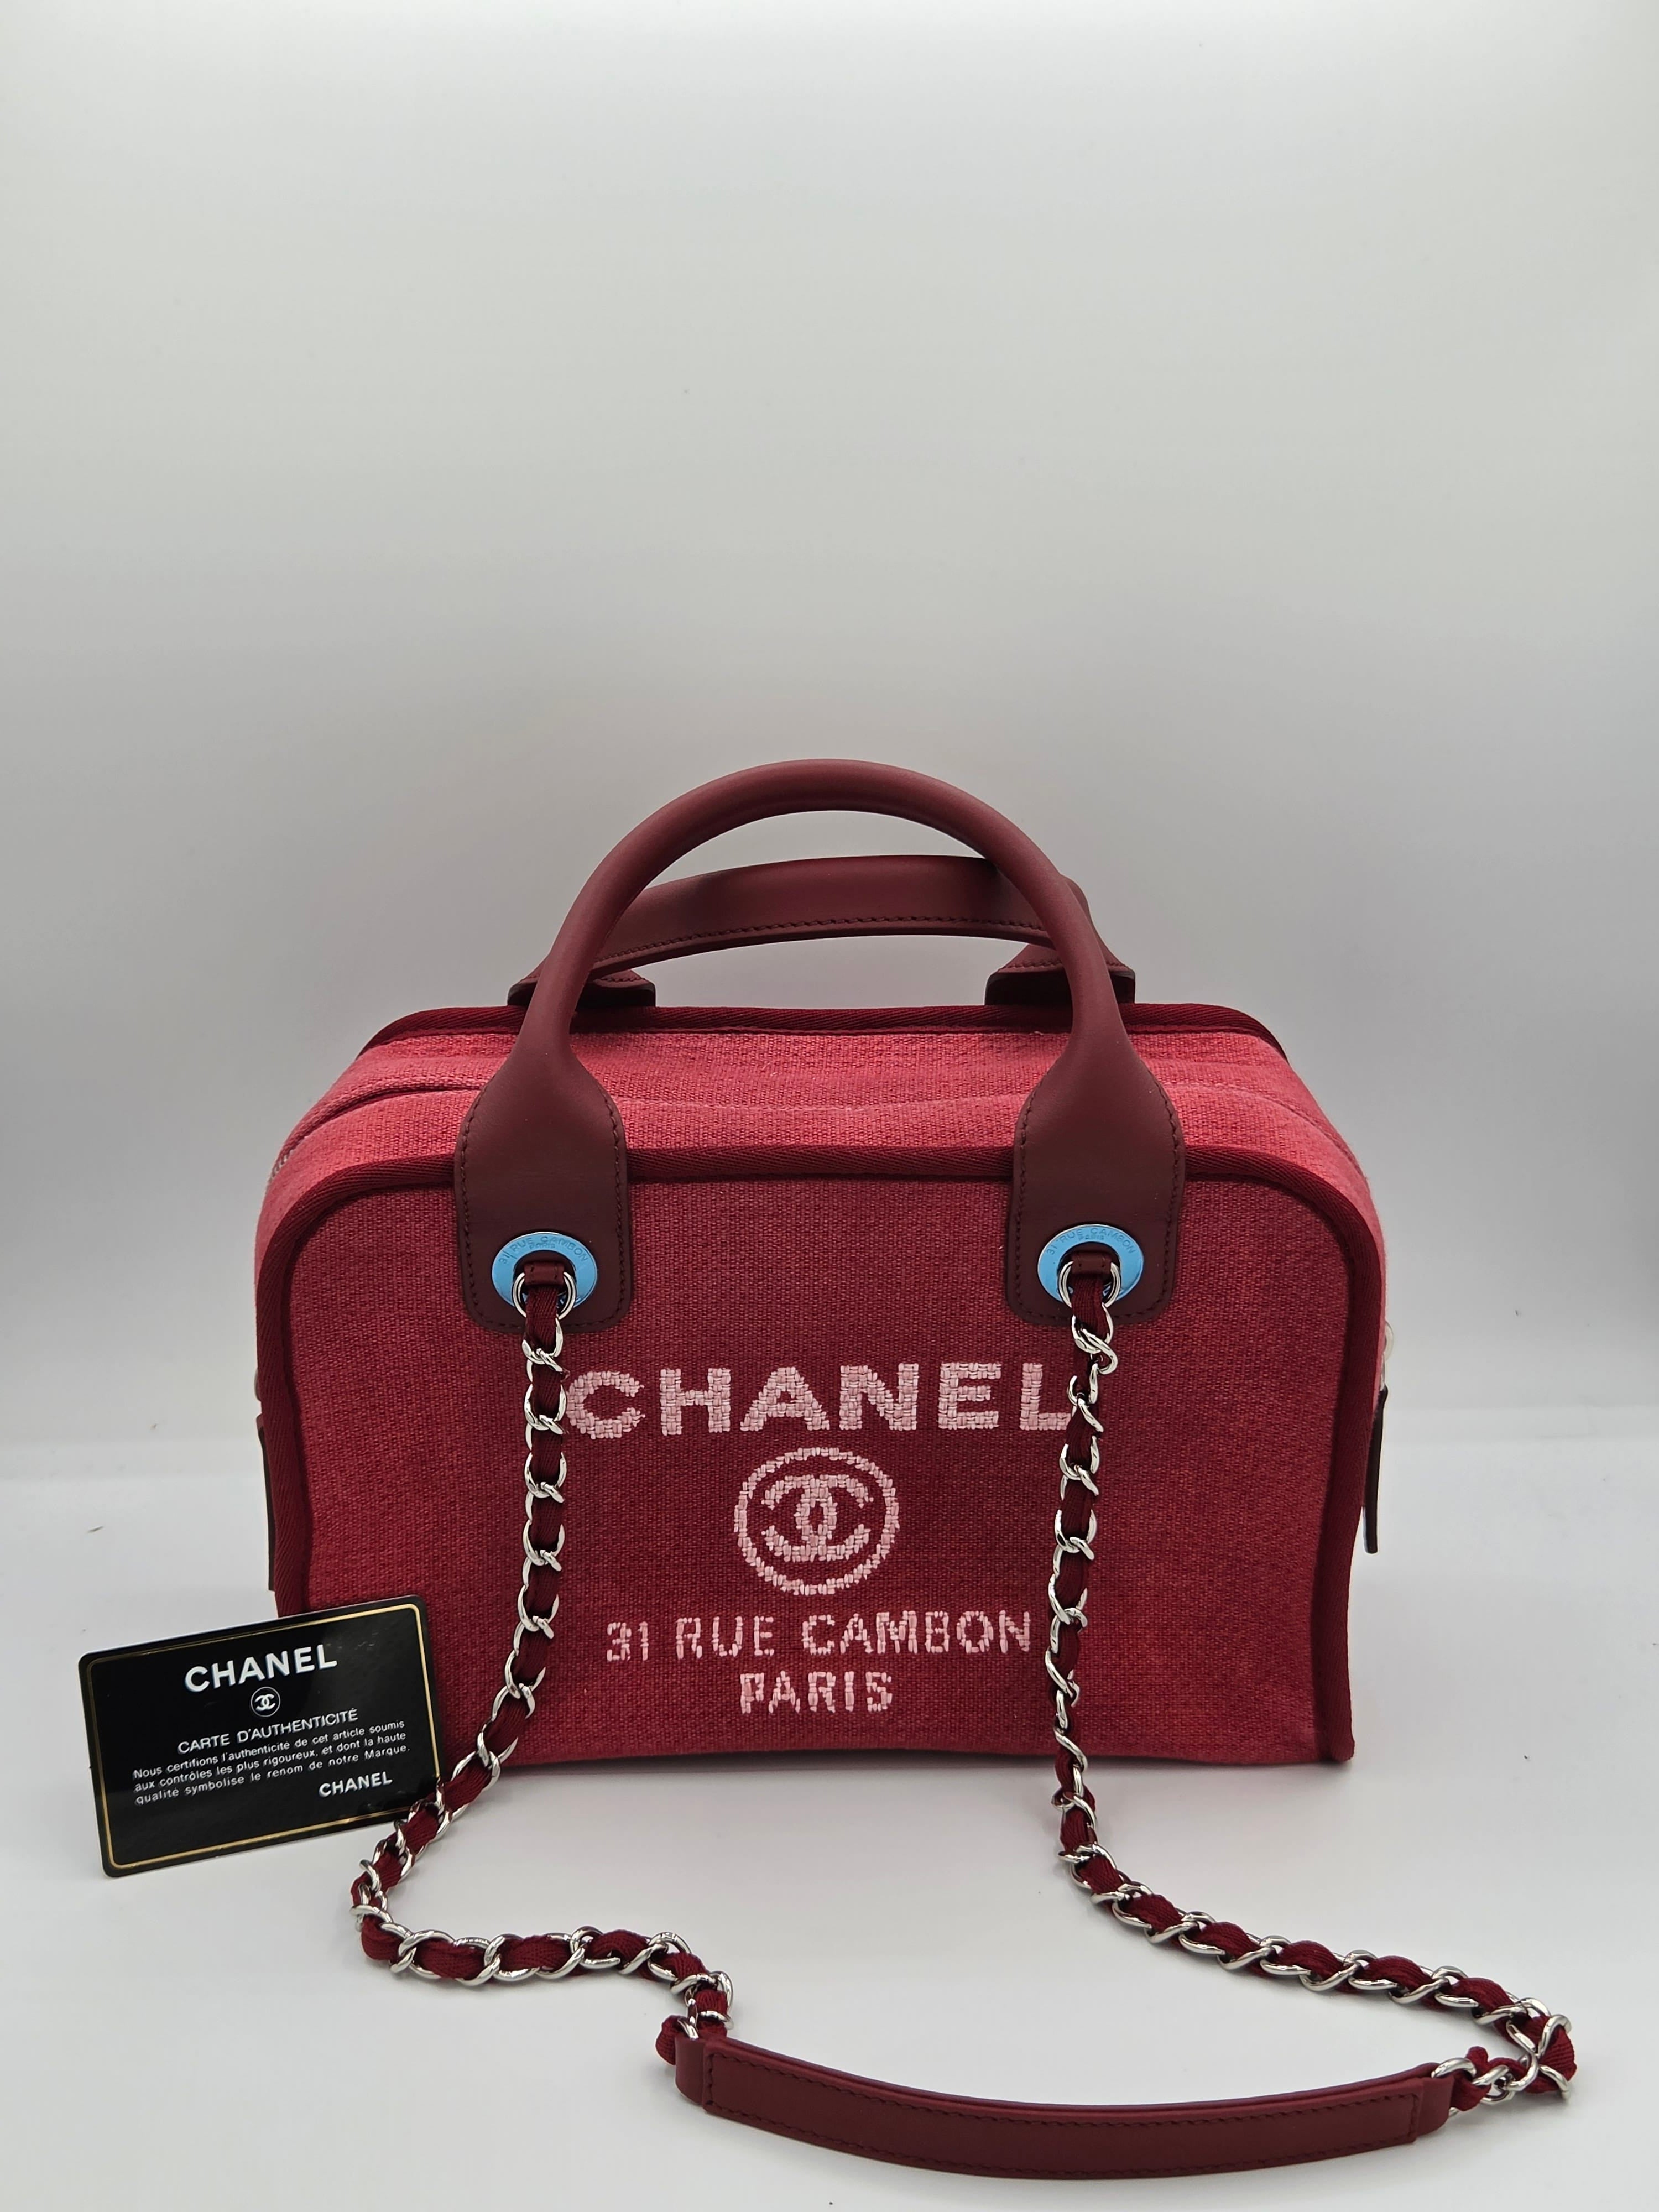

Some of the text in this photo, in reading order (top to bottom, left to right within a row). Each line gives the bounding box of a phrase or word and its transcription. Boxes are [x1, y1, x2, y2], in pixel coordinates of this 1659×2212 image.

[510, 1238, 534, 1253] RUE
[540, 1236, 589, 1262] CAMBON
[1046, 1228, 1136, 1255] 31 RUE CAMBON
[566, 1361, 1072, 1439] CHANEL
[606, 1609, 1031, 1662] 31 RUE CAMBON
[184, 1644, 337, 1693] CHANEL
[739, 1670, 893, 1715] PARIS
[133, 1720, 405, 1780] Nous certifions l'authenticité de cet article soumis
[177, 1708, 358, 1755] CARTE D'AUTHENTICITÉ
[133, 1781, 155, 1793] aux
[159, 1770, 213, 1787] contrôles
[216, 1765, 233, 1776] les
[235, 1760, 260, 1773] plus
[321, 1745, 333, 1755] et
[336, 1740, 360, 1752] dont
[364, 1738, 374, 1747] la
[377, 1732, 406, 1744] haute
[134, 1745, 410, 1806] qualité symbolise le renom de notre Marque.
[319, 1771, 393, 1797] CHANEL
